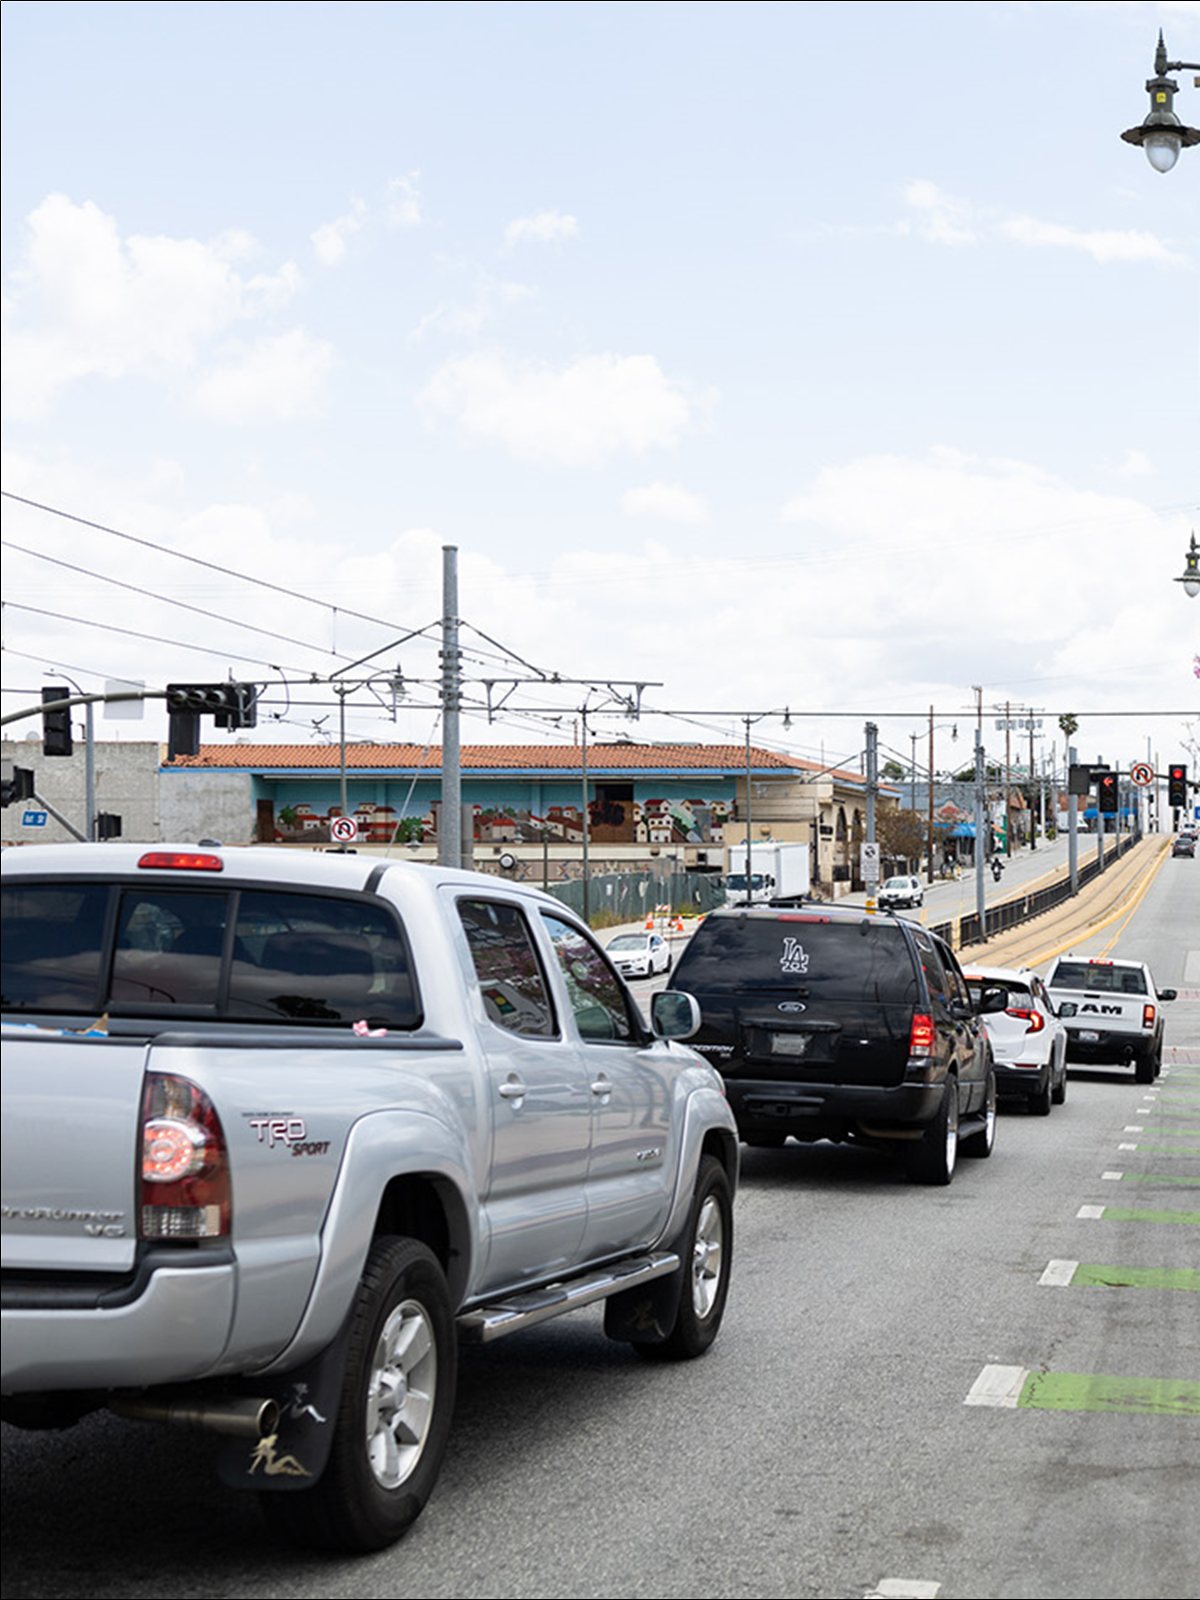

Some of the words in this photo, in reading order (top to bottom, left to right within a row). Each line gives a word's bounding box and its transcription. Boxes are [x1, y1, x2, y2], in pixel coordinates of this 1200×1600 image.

[780, 937, 810, 974] LA
[249, 1119, 307, 1149] TRD
[292, 1141, 330, 1157] SPORT
